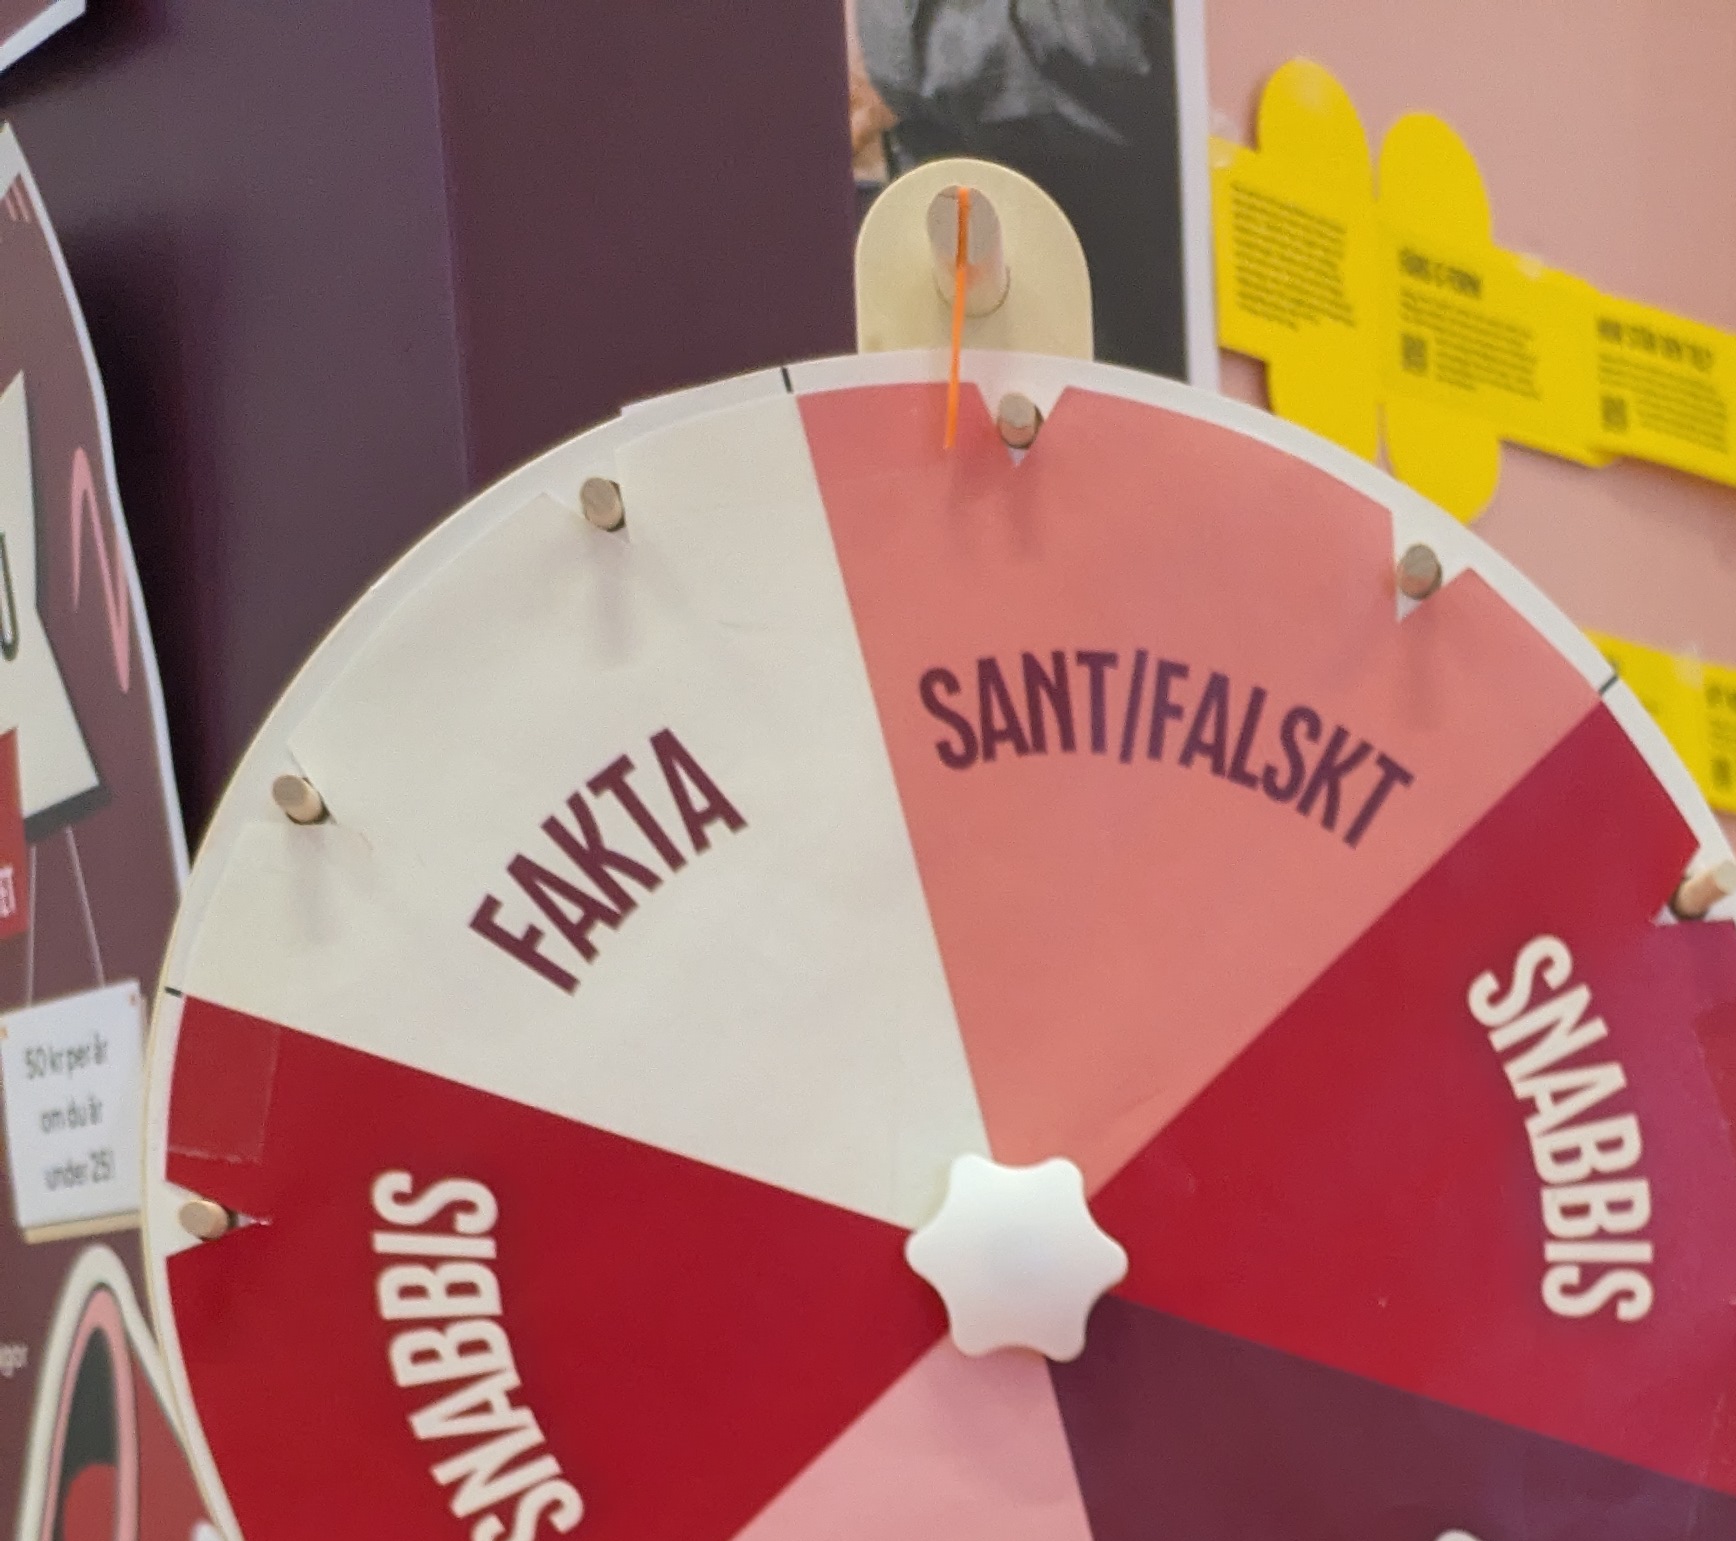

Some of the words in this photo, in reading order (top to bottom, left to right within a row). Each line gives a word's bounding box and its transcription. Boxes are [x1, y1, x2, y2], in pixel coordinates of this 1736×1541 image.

[469, 728, 747, 993] FAKTA
[918, 649, 1414, 848] SANT/FALSKT
[1468, 934, 1654, 1323] SNABBIS
